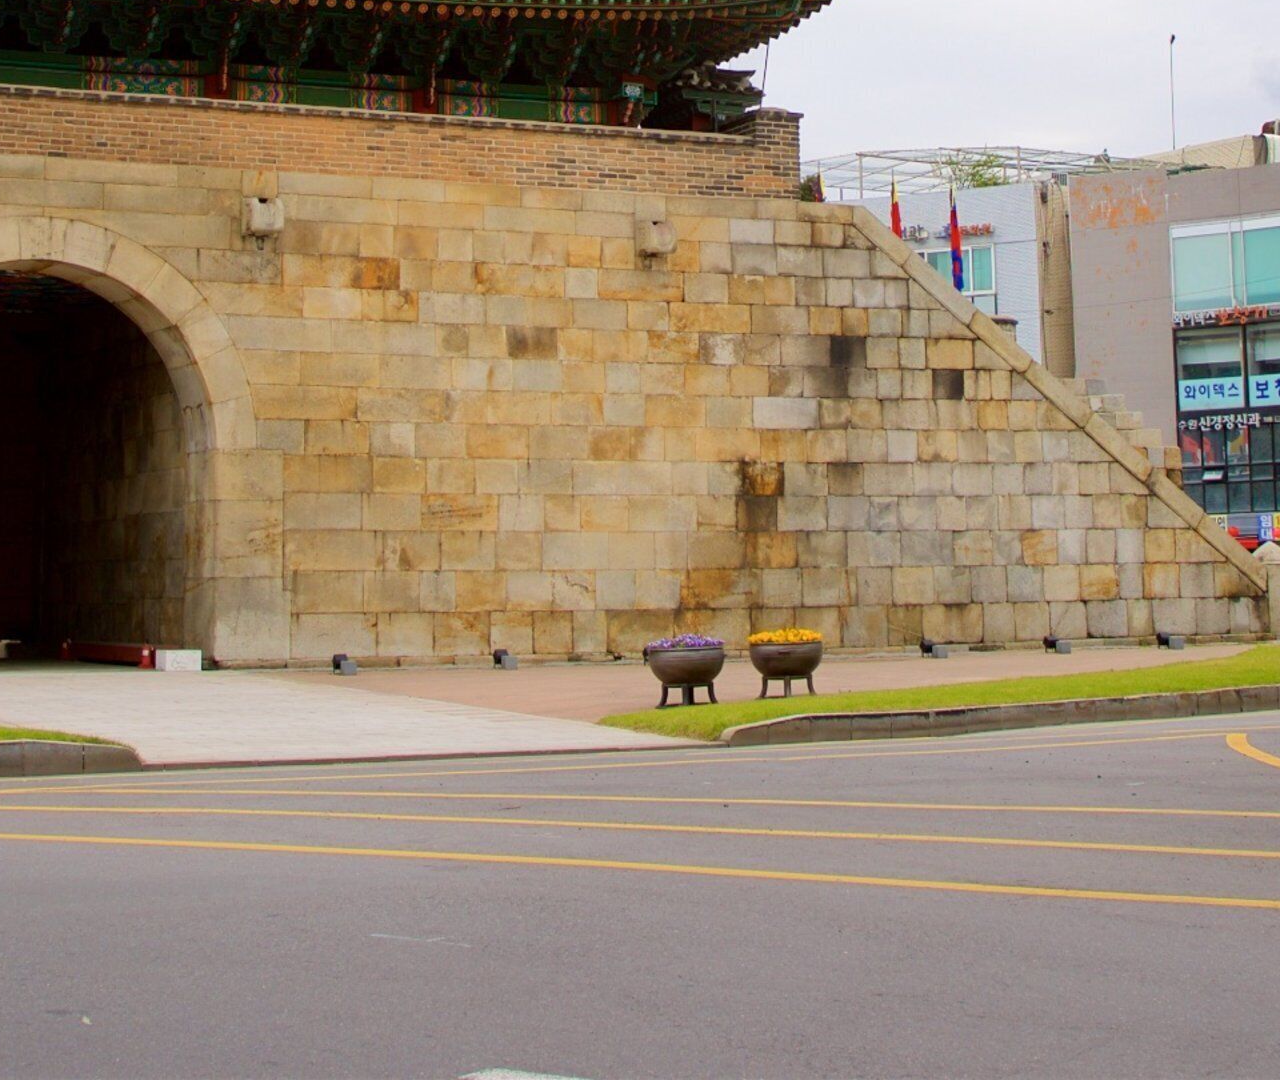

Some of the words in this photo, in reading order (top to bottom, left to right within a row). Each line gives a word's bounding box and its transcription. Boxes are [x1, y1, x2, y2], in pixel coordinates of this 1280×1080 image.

[1184, 383, 1239, 399] 와이덱스
[1178, 419, 1198, 430] 수원
[1198, 413, 1261, 431] 신경정신과
[1259, 514, 1273, 539] 임대
